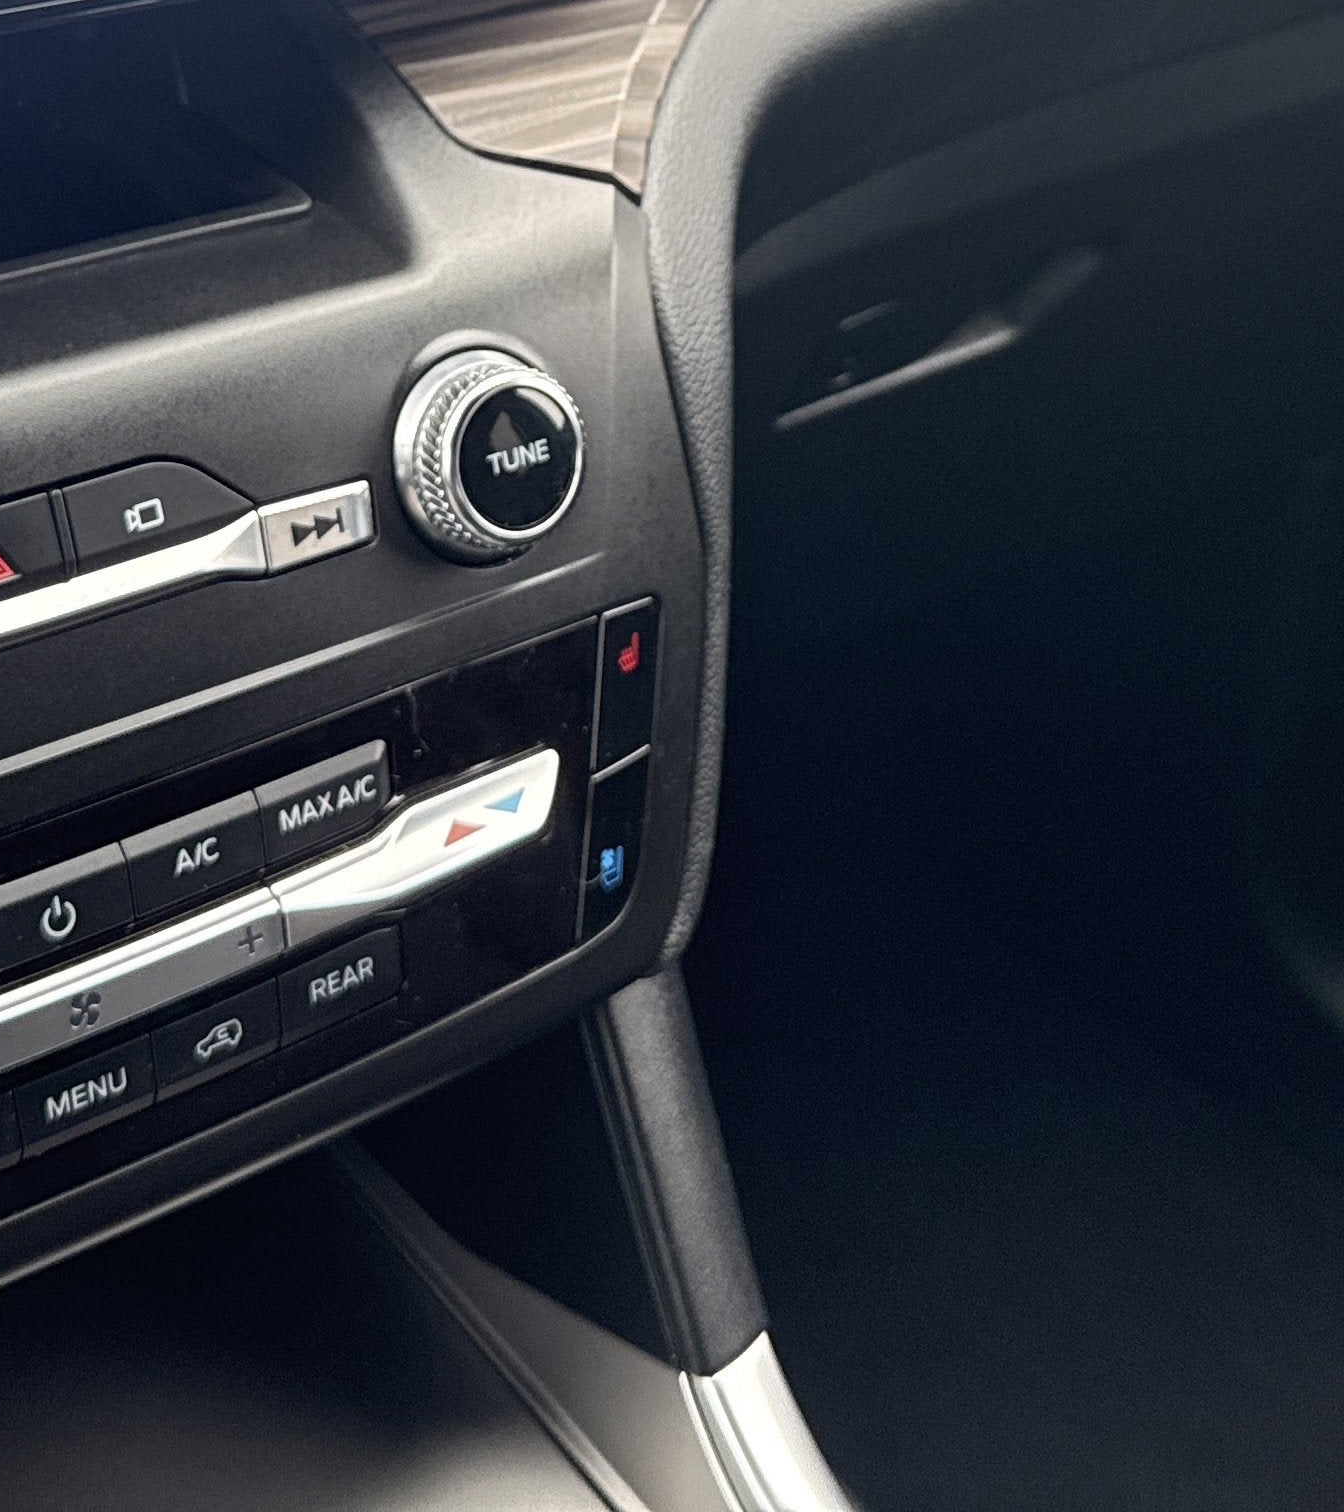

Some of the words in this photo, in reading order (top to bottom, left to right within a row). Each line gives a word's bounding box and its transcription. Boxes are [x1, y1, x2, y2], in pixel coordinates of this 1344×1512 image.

[485, 438, 551, 476] TUNE
[278, 791, 332, 833] MAX
[337, 774, 377, 809] A/C
[173, 837, 220, 878] A/C
[308, 956, 374, 1005] REAR
[44, 1066, 128, 1123] MENU
